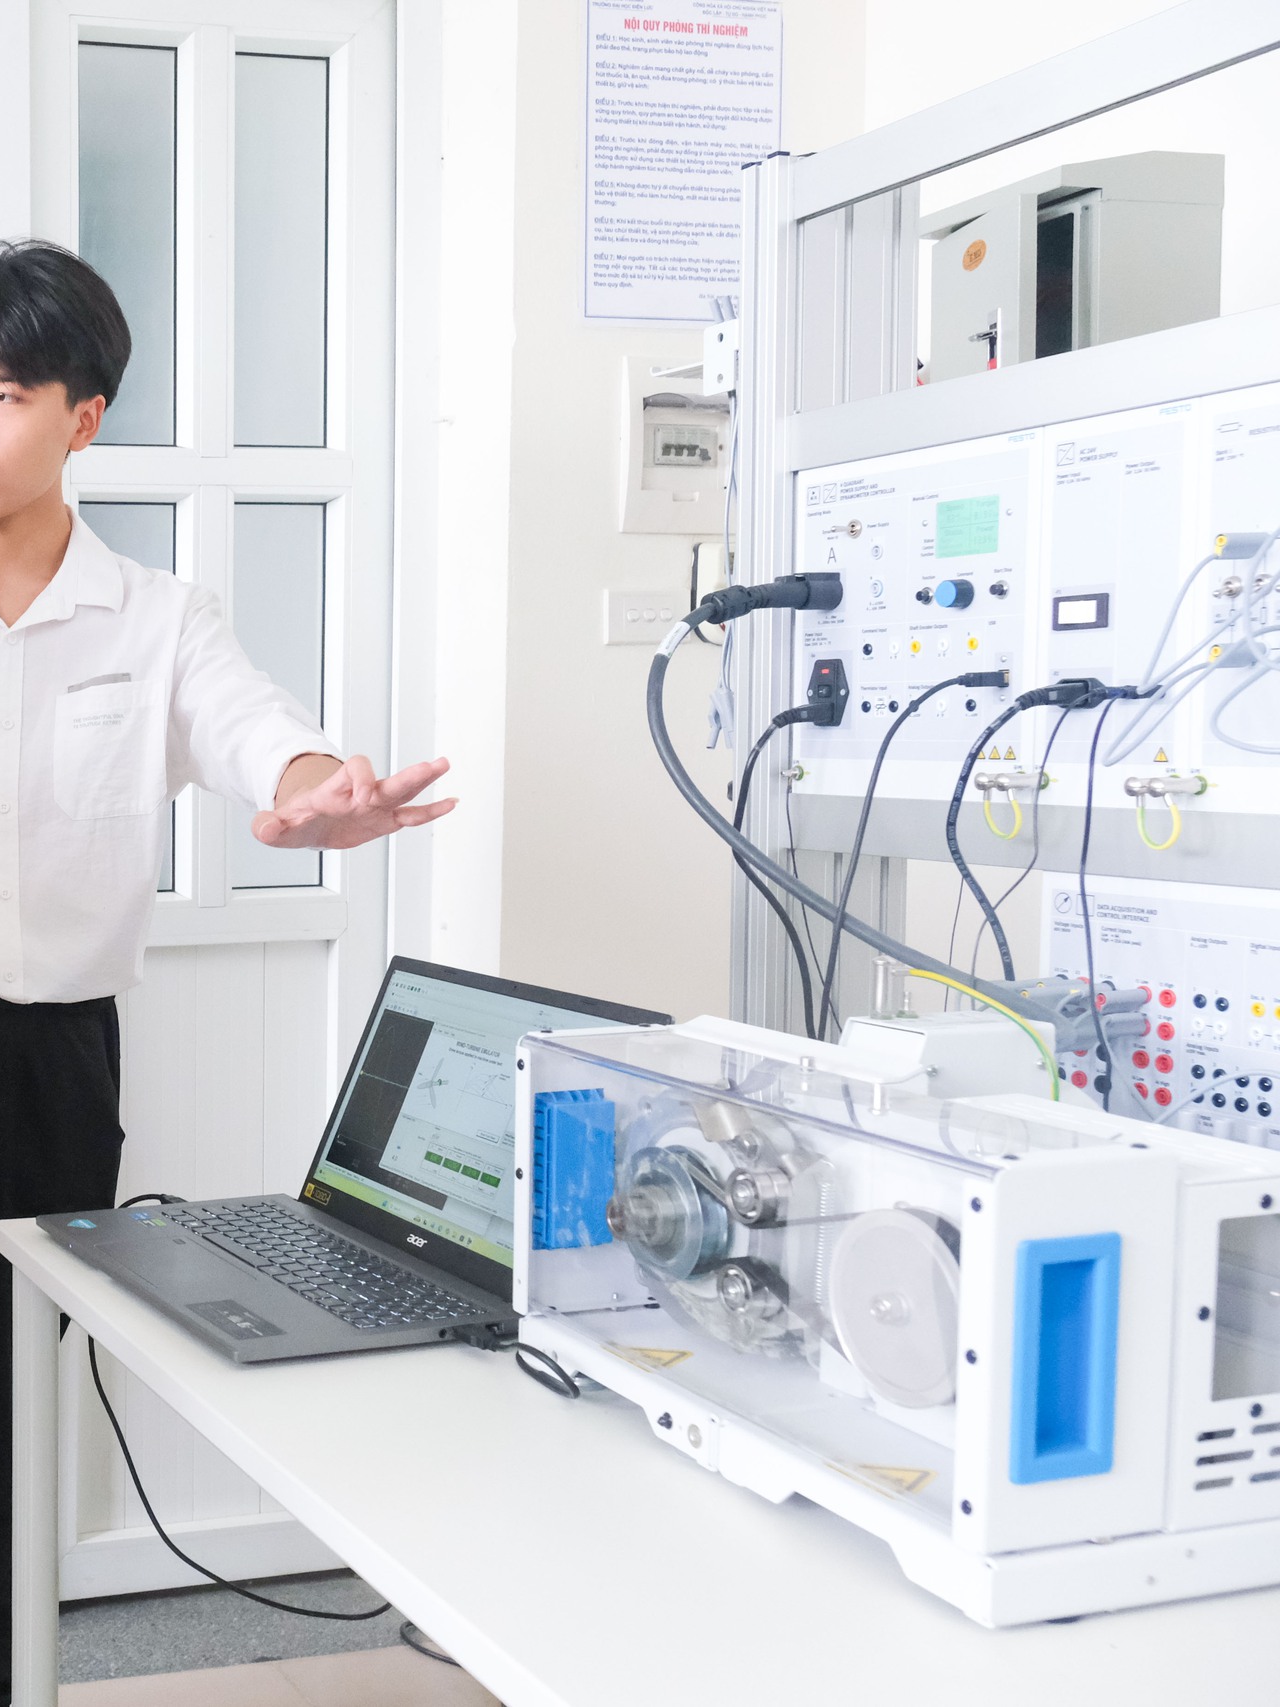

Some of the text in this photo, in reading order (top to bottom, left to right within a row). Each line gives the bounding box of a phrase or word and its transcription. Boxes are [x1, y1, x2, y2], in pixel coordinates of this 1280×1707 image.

[624, 17, 748, 39] NỘI QUY PHÒNG THÍ NGHIỆM
[694, 49, 708, 57] động
[1159, 404, 1191, 415] FESTO
[1008, 433, 1035, 442] FESTO
[827, 547, 836, 565] A
[1111, 905, 1144, 914] ACQUISITION
[1122, 914, 1150, 922] INTERFACE
[406, 1233, 428, 1248] acer
